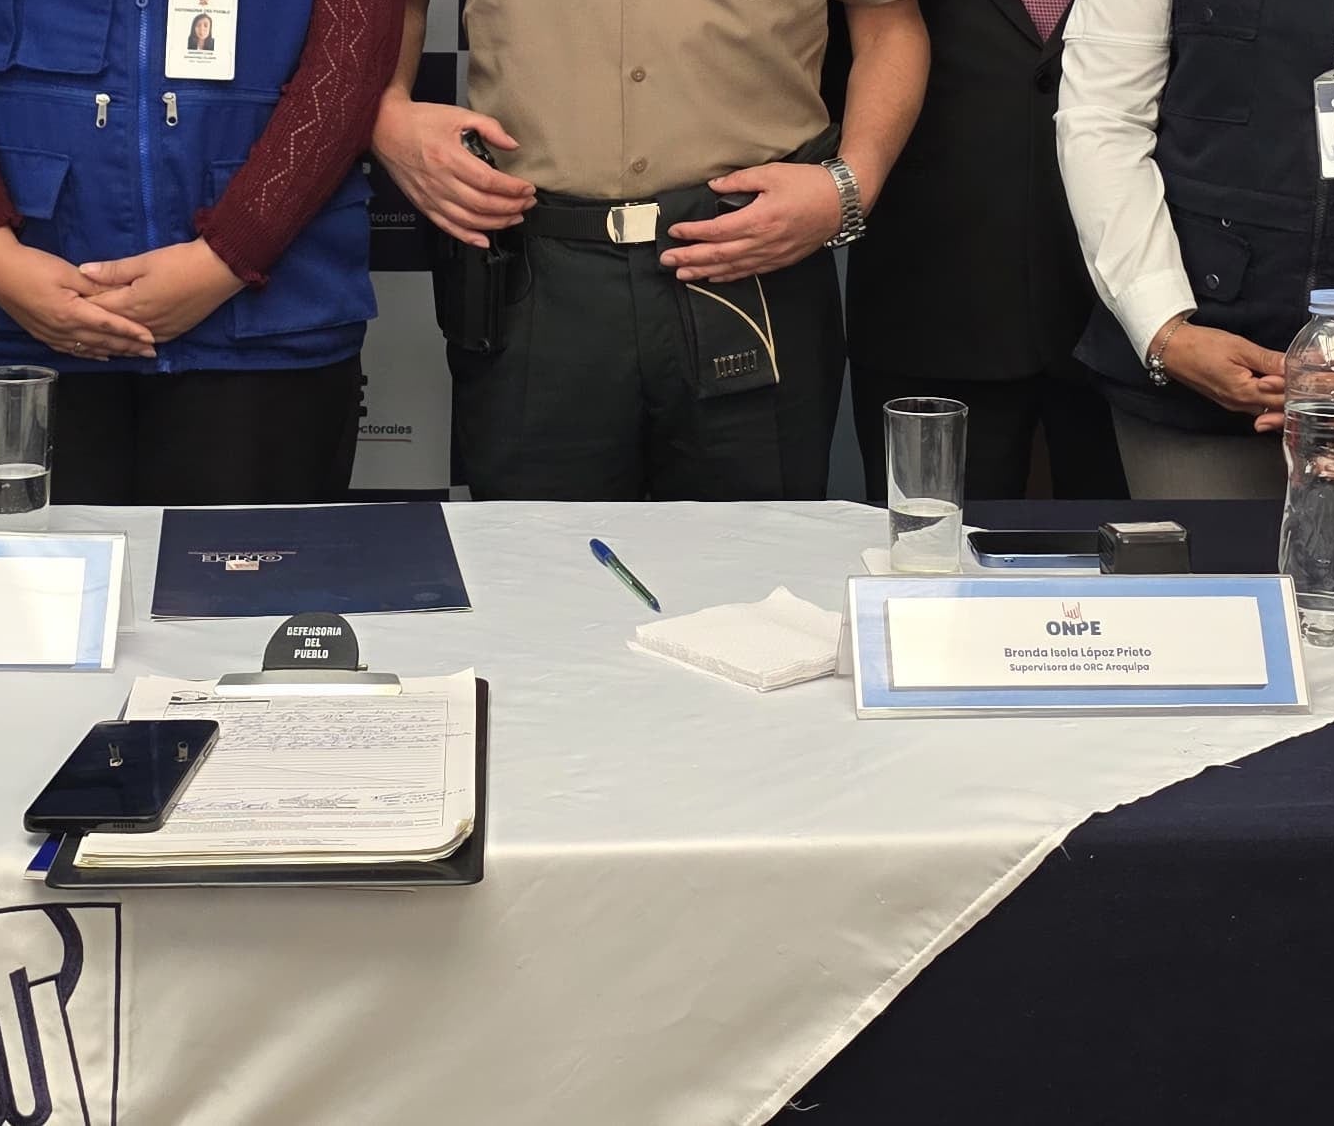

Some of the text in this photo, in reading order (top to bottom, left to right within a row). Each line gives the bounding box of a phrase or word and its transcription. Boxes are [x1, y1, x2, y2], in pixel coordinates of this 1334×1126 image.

[371, 211, 416, 223] torales
[360, 424, 412, 434] ctorales
[286, 626, 342, 636] DEFENSORIA
[1046, 621, 1102, 636] ONPE
[304, 637, 321, 647] DEL
[294, 649, 329, 659] PUEBLO
[1004, 647, 1048, 658] Brenda
[1081, 646, 1115, 660] López
[1116, 647, 1152, 657] Prieto
[1009, 662, 1150, 674] Supervisora de ORC Arequipa
